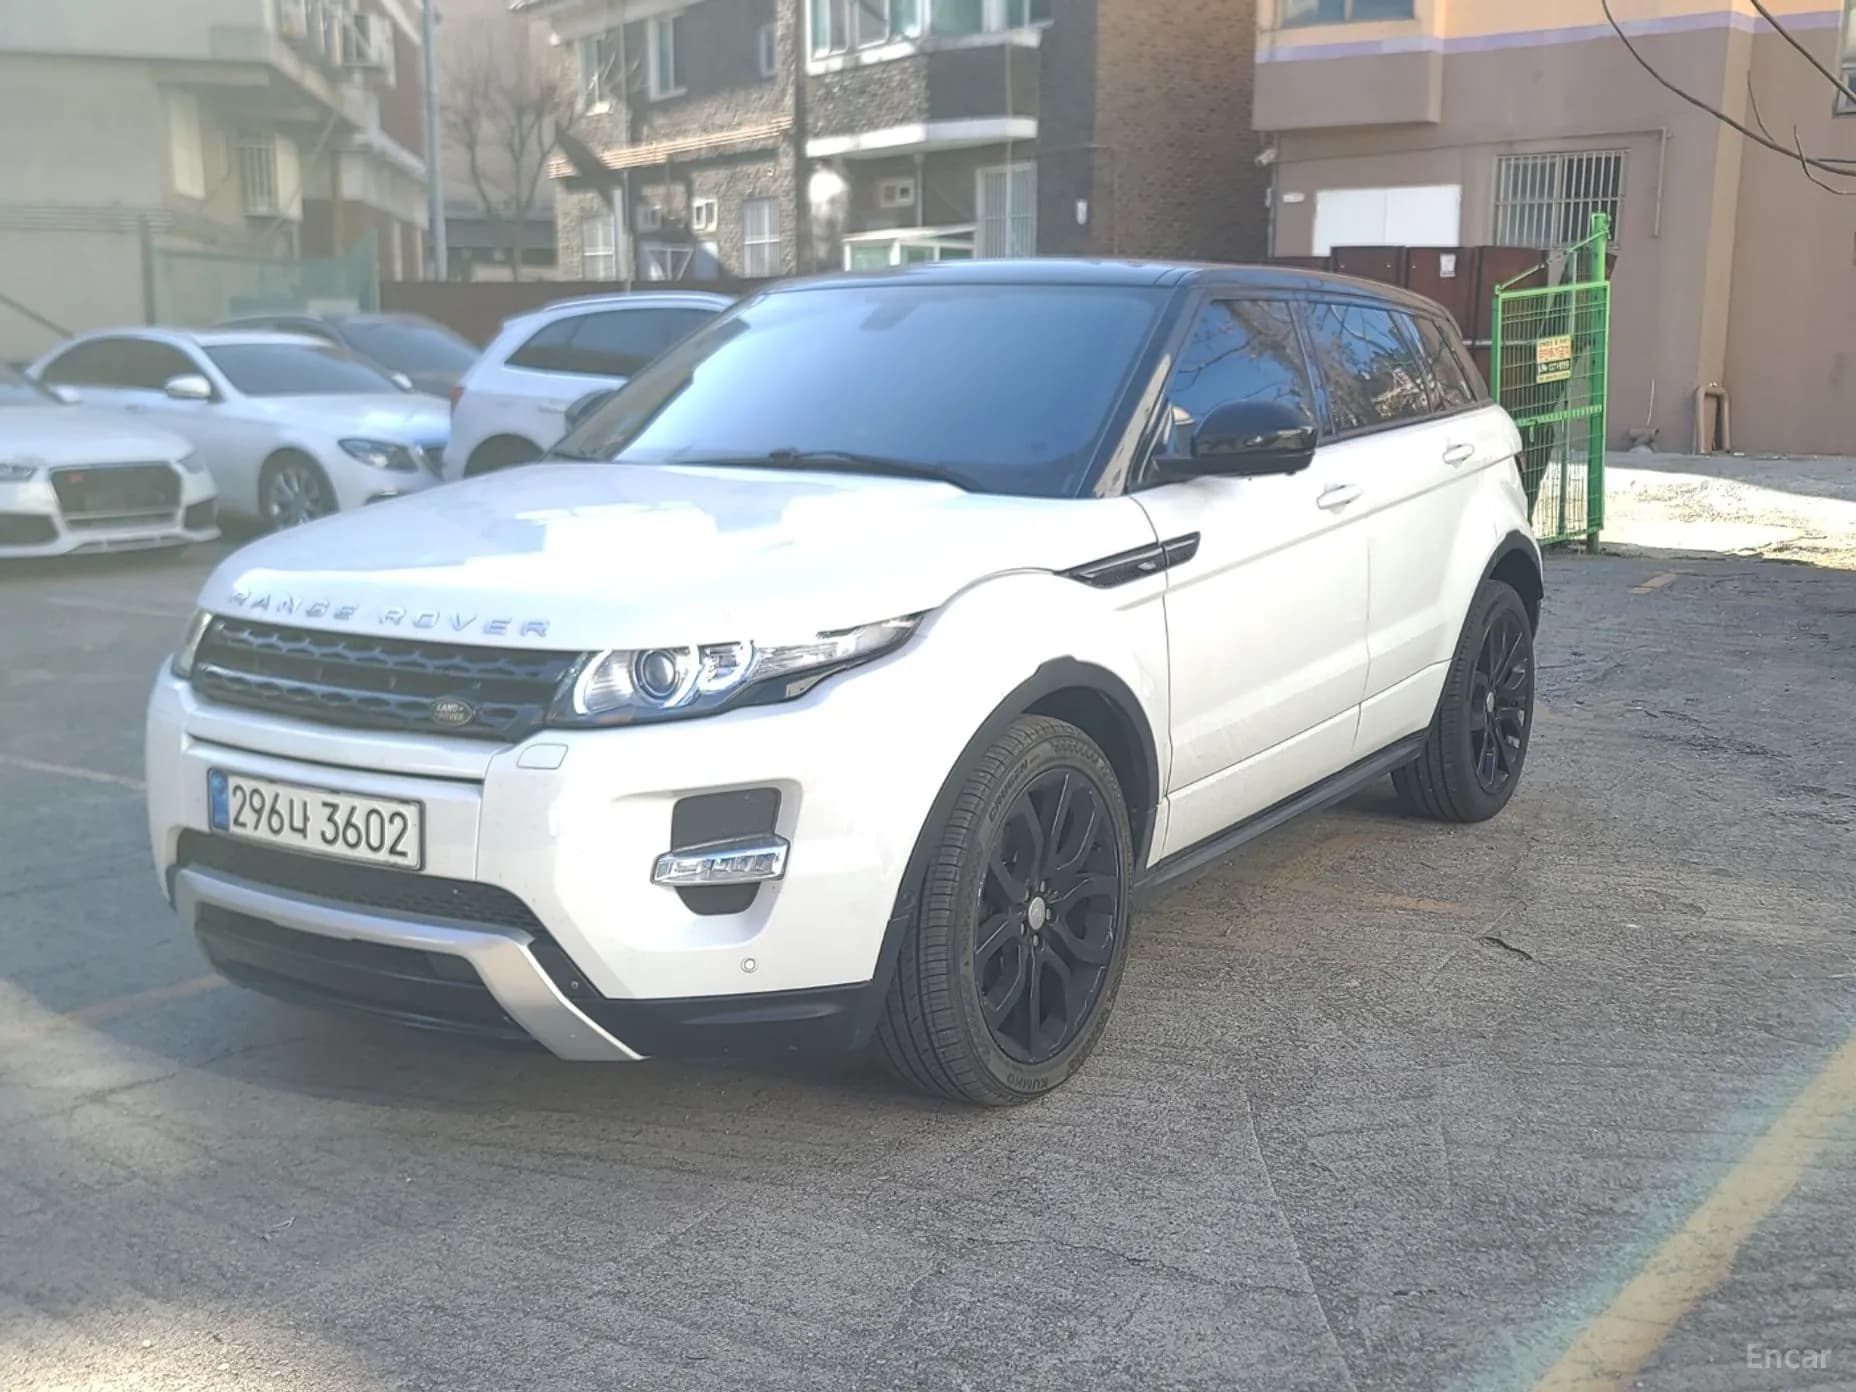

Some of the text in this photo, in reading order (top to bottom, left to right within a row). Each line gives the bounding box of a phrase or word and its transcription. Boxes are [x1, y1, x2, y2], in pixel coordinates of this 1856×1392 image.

[229, 590, 551, 638] RANGE ROVER
[231, 784, 409, 858] 296나 3602
